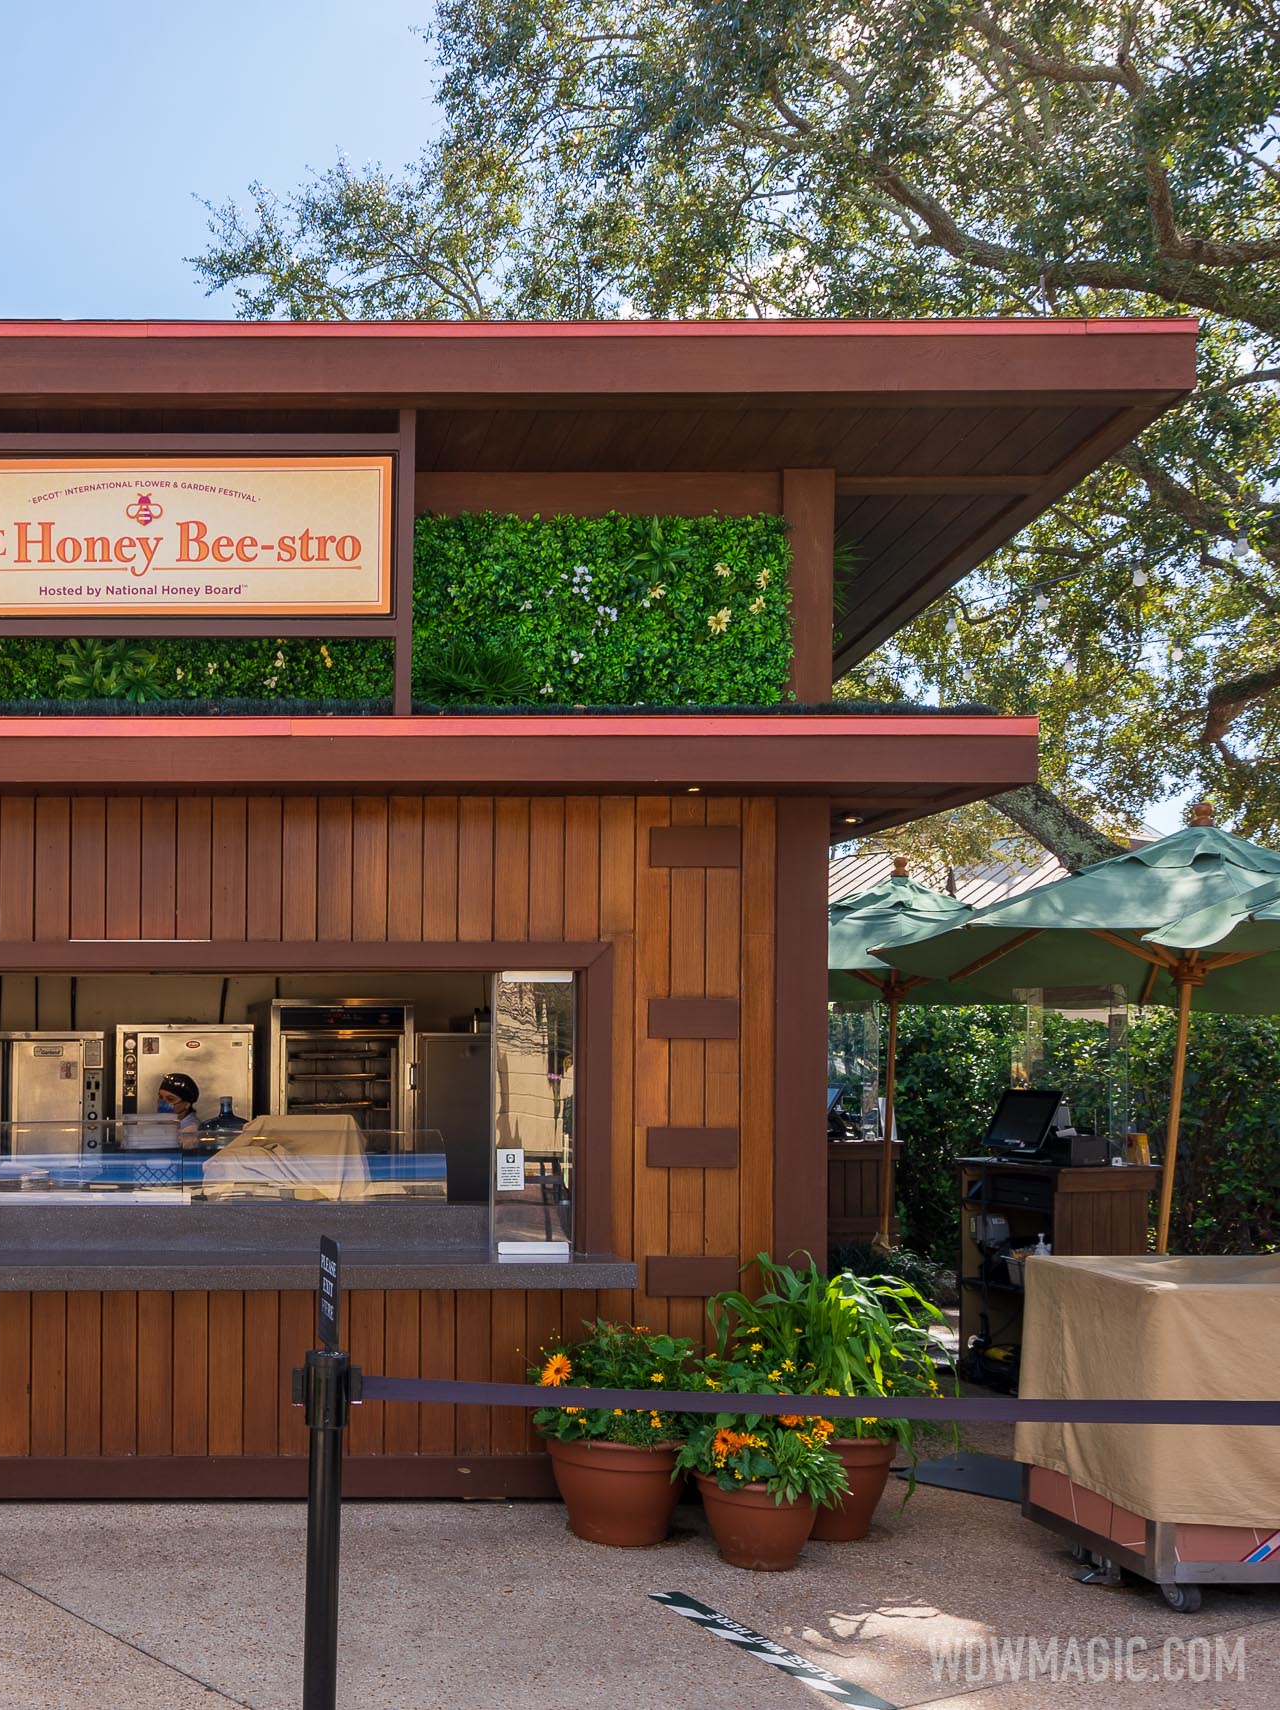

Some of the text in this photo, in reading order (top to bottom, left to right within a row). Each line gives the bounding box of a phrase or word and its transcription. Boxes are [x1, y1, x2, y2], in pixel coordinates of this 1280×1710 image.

[64, 480, 133, 496] INTERNATIONAL
[135, 480, 171, 488] FLOWER
[181, 482, 217, 493] GARDEN
[218, 487, 257, 502] FESTIVAL
[13, 521, 163, 577] Honey
[176, 520, 362, 563] Bee-stro
[39, 586, 82, 596] Hosted
[86, 586, 101, 597] by
[106, 585, 157, 595] National
[161, 585, 200, 596] Honey
[322, 1276, 334, 1297] EXIT
[783, 1654, 842, 1681] PLEASE
